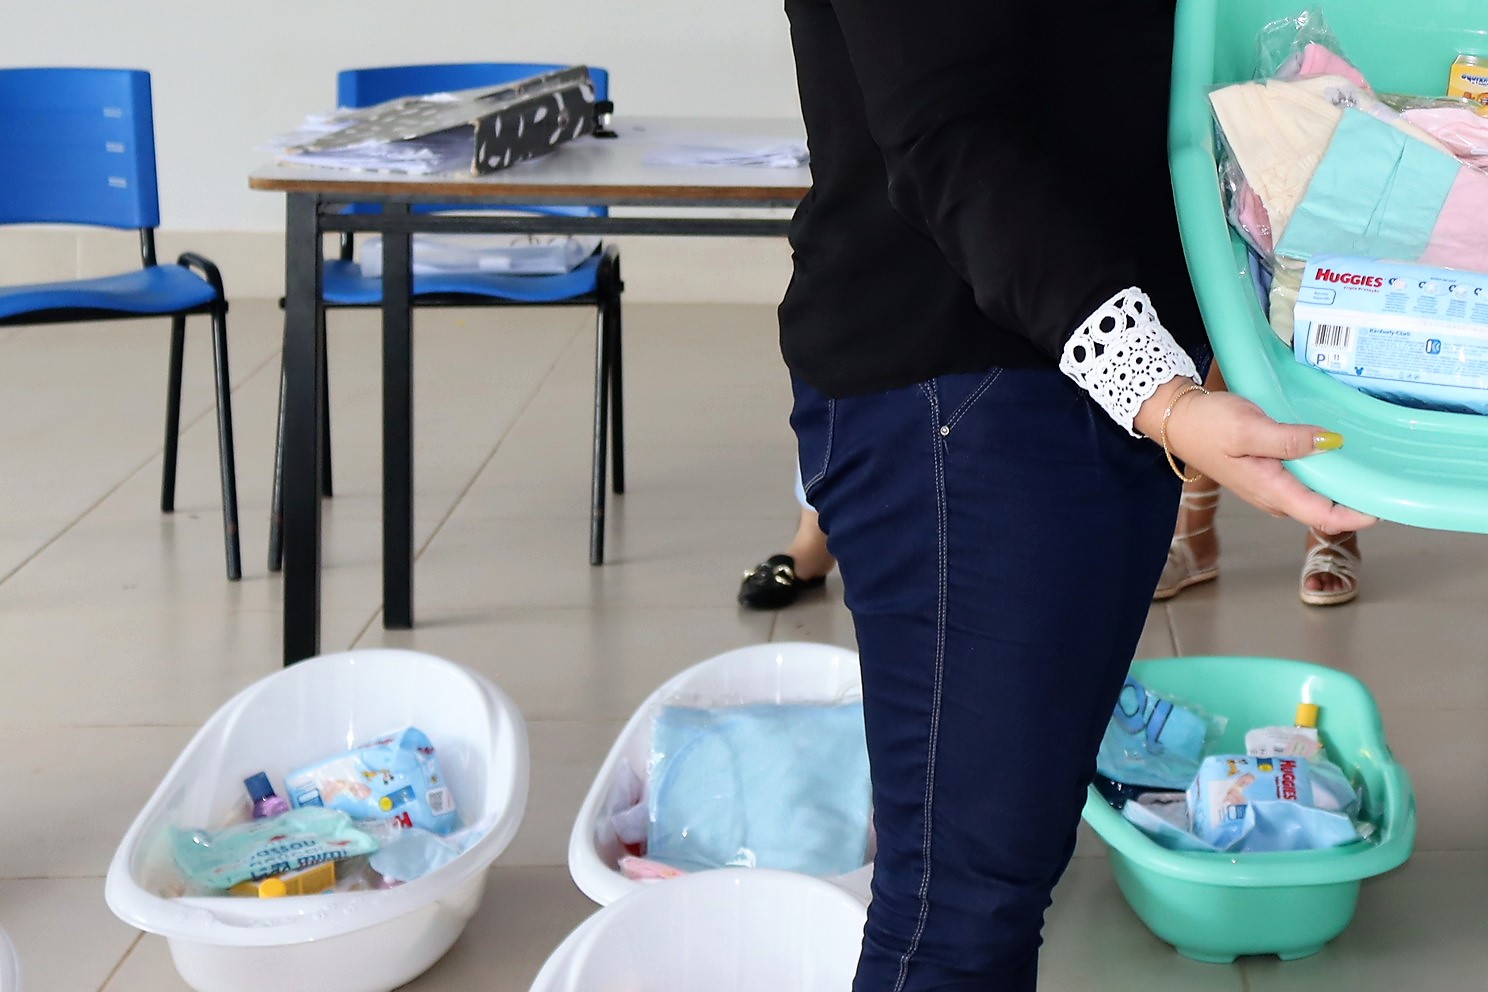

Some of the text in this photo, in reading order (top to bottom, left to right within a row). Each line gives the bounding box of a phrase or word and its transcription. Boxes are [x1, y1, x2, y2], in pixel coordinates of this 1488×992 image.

[1315, 268, 1384, 288] HUGGIES
[1316, 353, 1326, 365] P
[1280, 759, 1297, 801] HUGGIES
